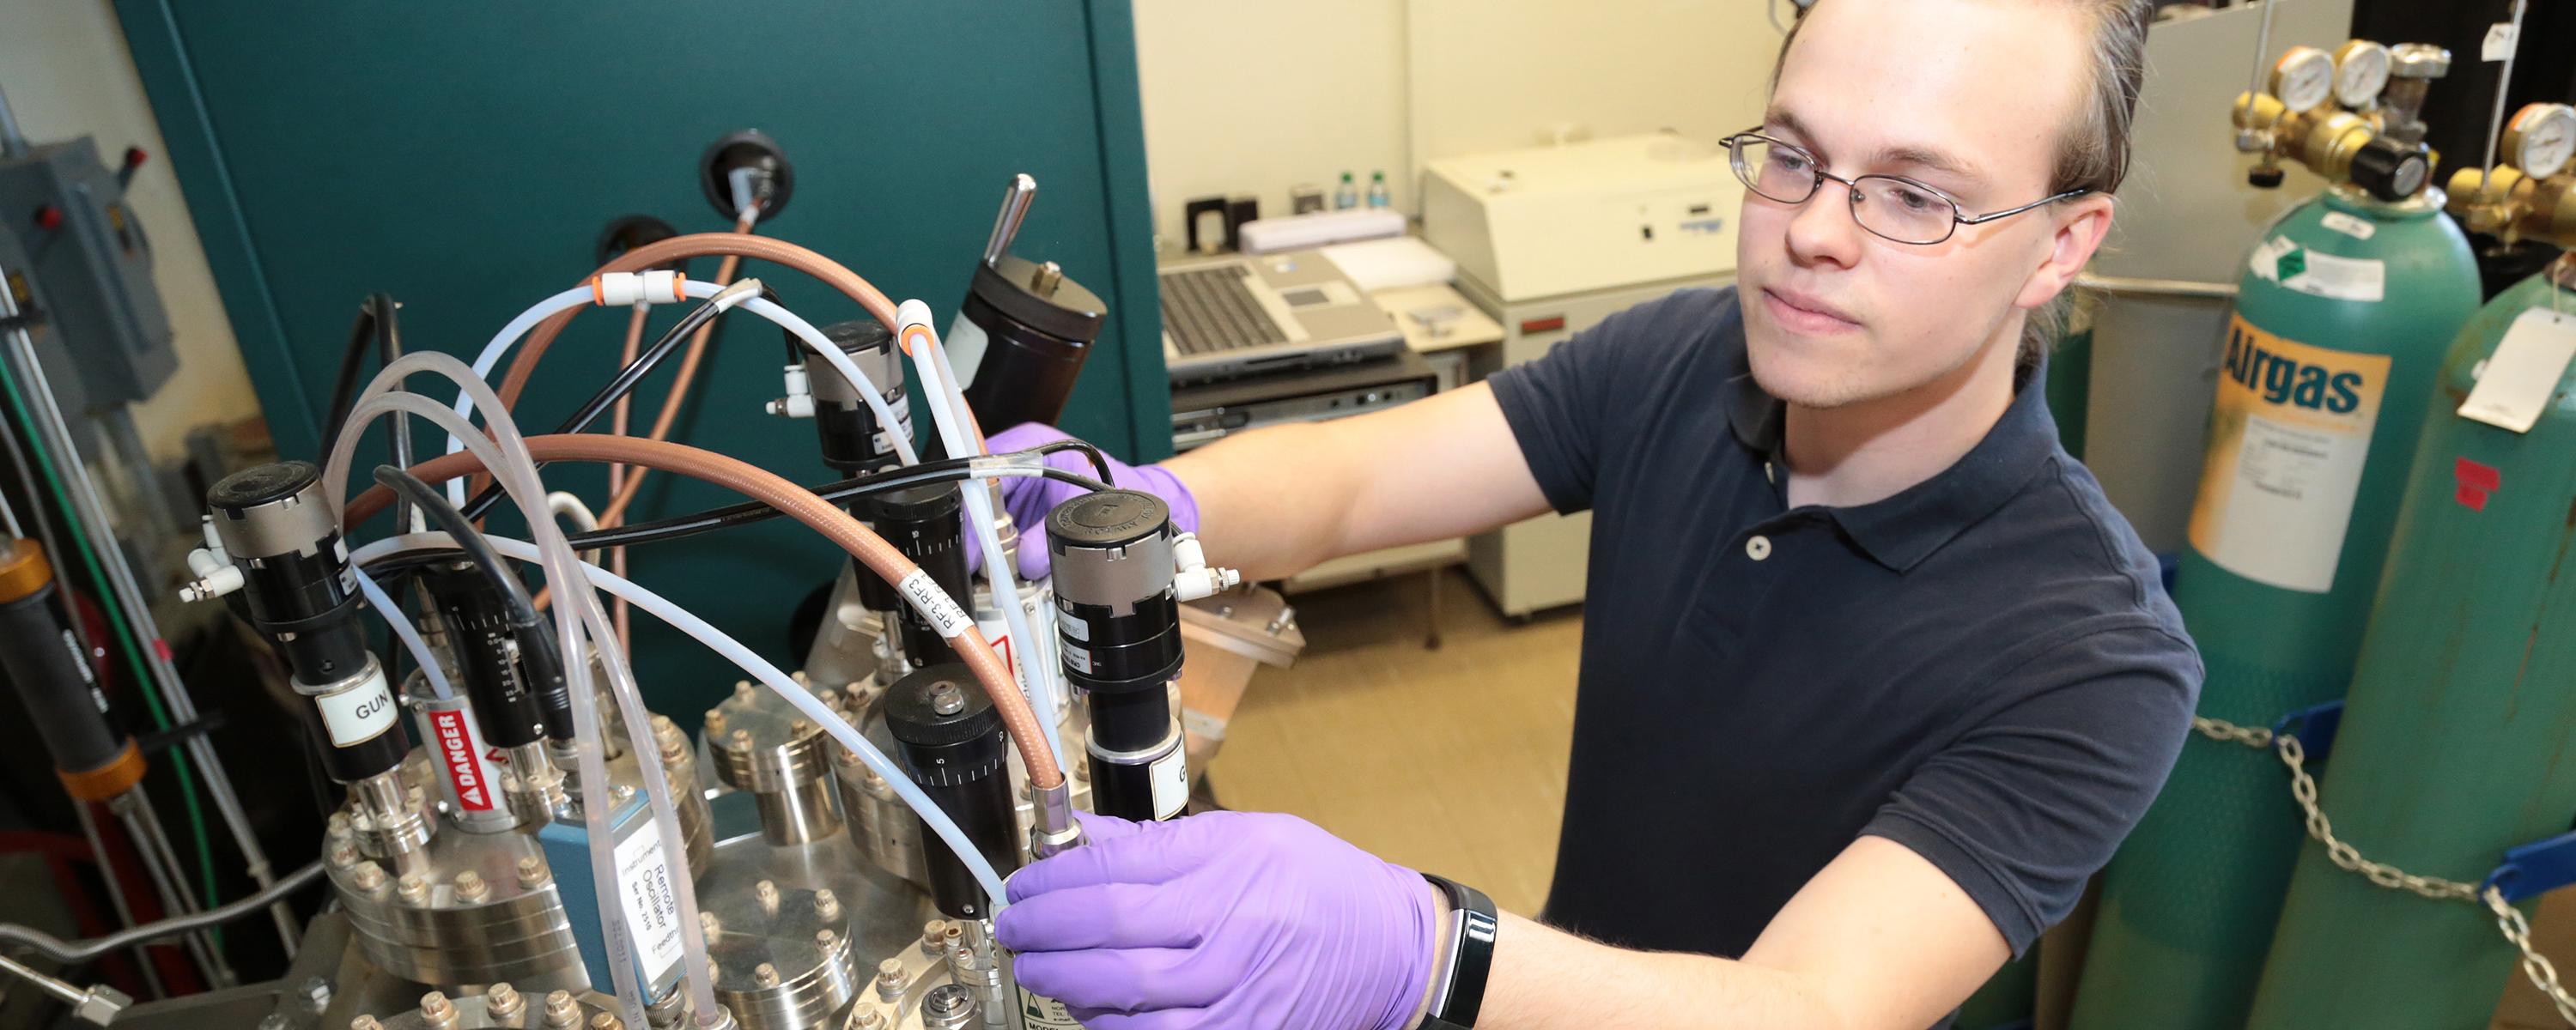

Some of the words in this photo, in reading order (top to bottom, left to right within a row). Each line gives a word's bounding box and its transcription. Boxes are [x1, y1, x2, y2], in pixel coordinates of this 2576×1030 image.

[2227, 325, 2363, 415] Airgas
[909, 579, 956, 629] RF3-RF3
[356, 689, 388, 719] GUN
[438, 715, 477, 787] DANGER
[643, 869, 666, 929] Oscillator
[654, 863, 674, 916] Remote
